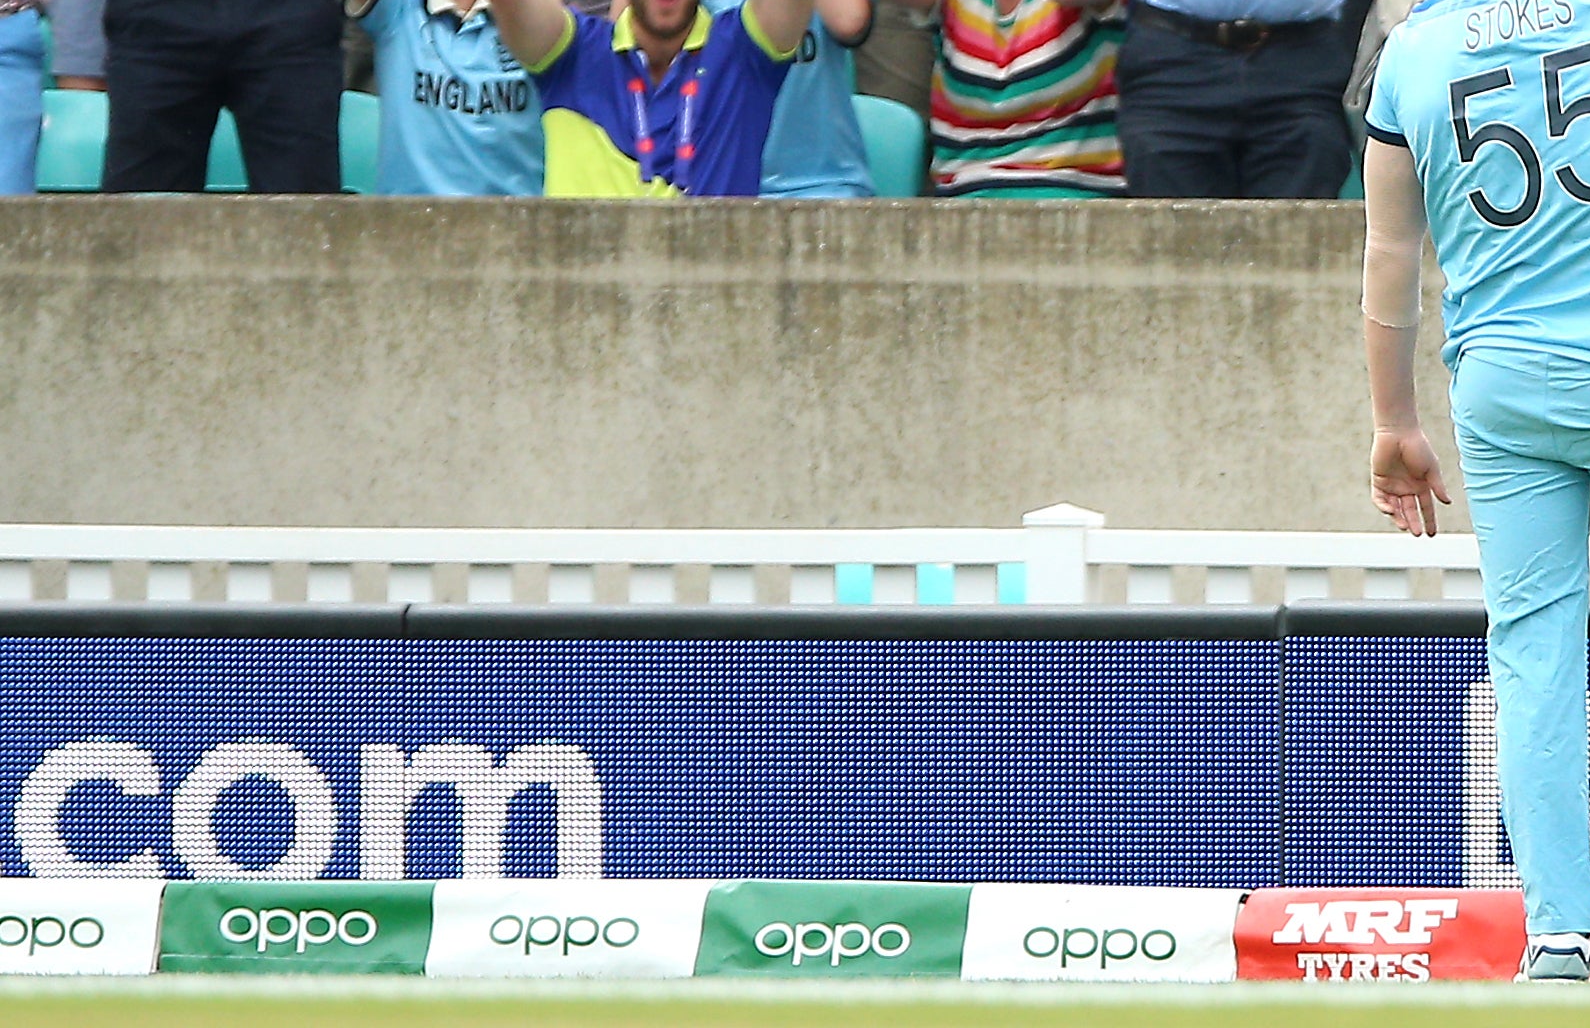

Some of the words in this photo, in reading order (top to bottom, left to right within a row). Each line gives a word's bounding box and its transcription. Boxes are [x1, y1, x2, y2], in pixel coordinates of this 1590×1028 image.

[413, 71, 529, 114] ENGLAND
[219, 907, 378, 953] oppo
[489, 915, 640, 955] oppo
[1272, 899, 1459, 944] MRF
[754, 922, 911, 966] oppo
[1023, 926, 1177, 969] oppo
[1297, 952, 1430, 982] TYRES
